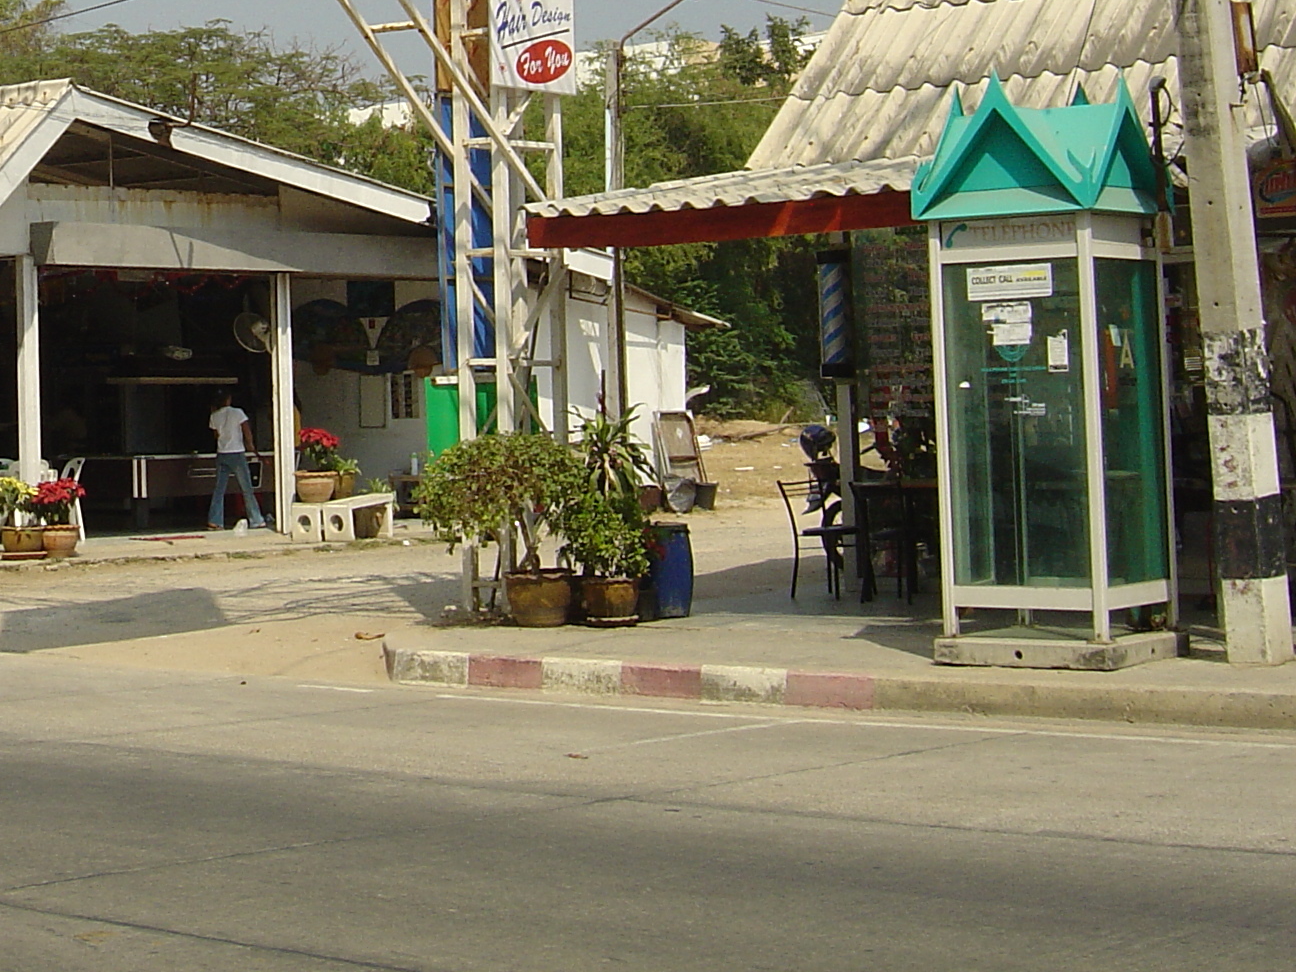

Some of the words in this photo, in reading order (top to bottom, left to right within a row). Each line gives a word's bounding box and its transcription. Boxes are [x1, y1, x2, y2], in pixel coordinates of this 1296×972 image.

[495, 1, 528, 44] Hair
[531, 1, 572, 28] Design
[520, 53, 543, 78] For
[545, 45, 570, 70] You
[971, 275, 996, 285] COLLECT
[998, 275, 1013, 284] CALL
